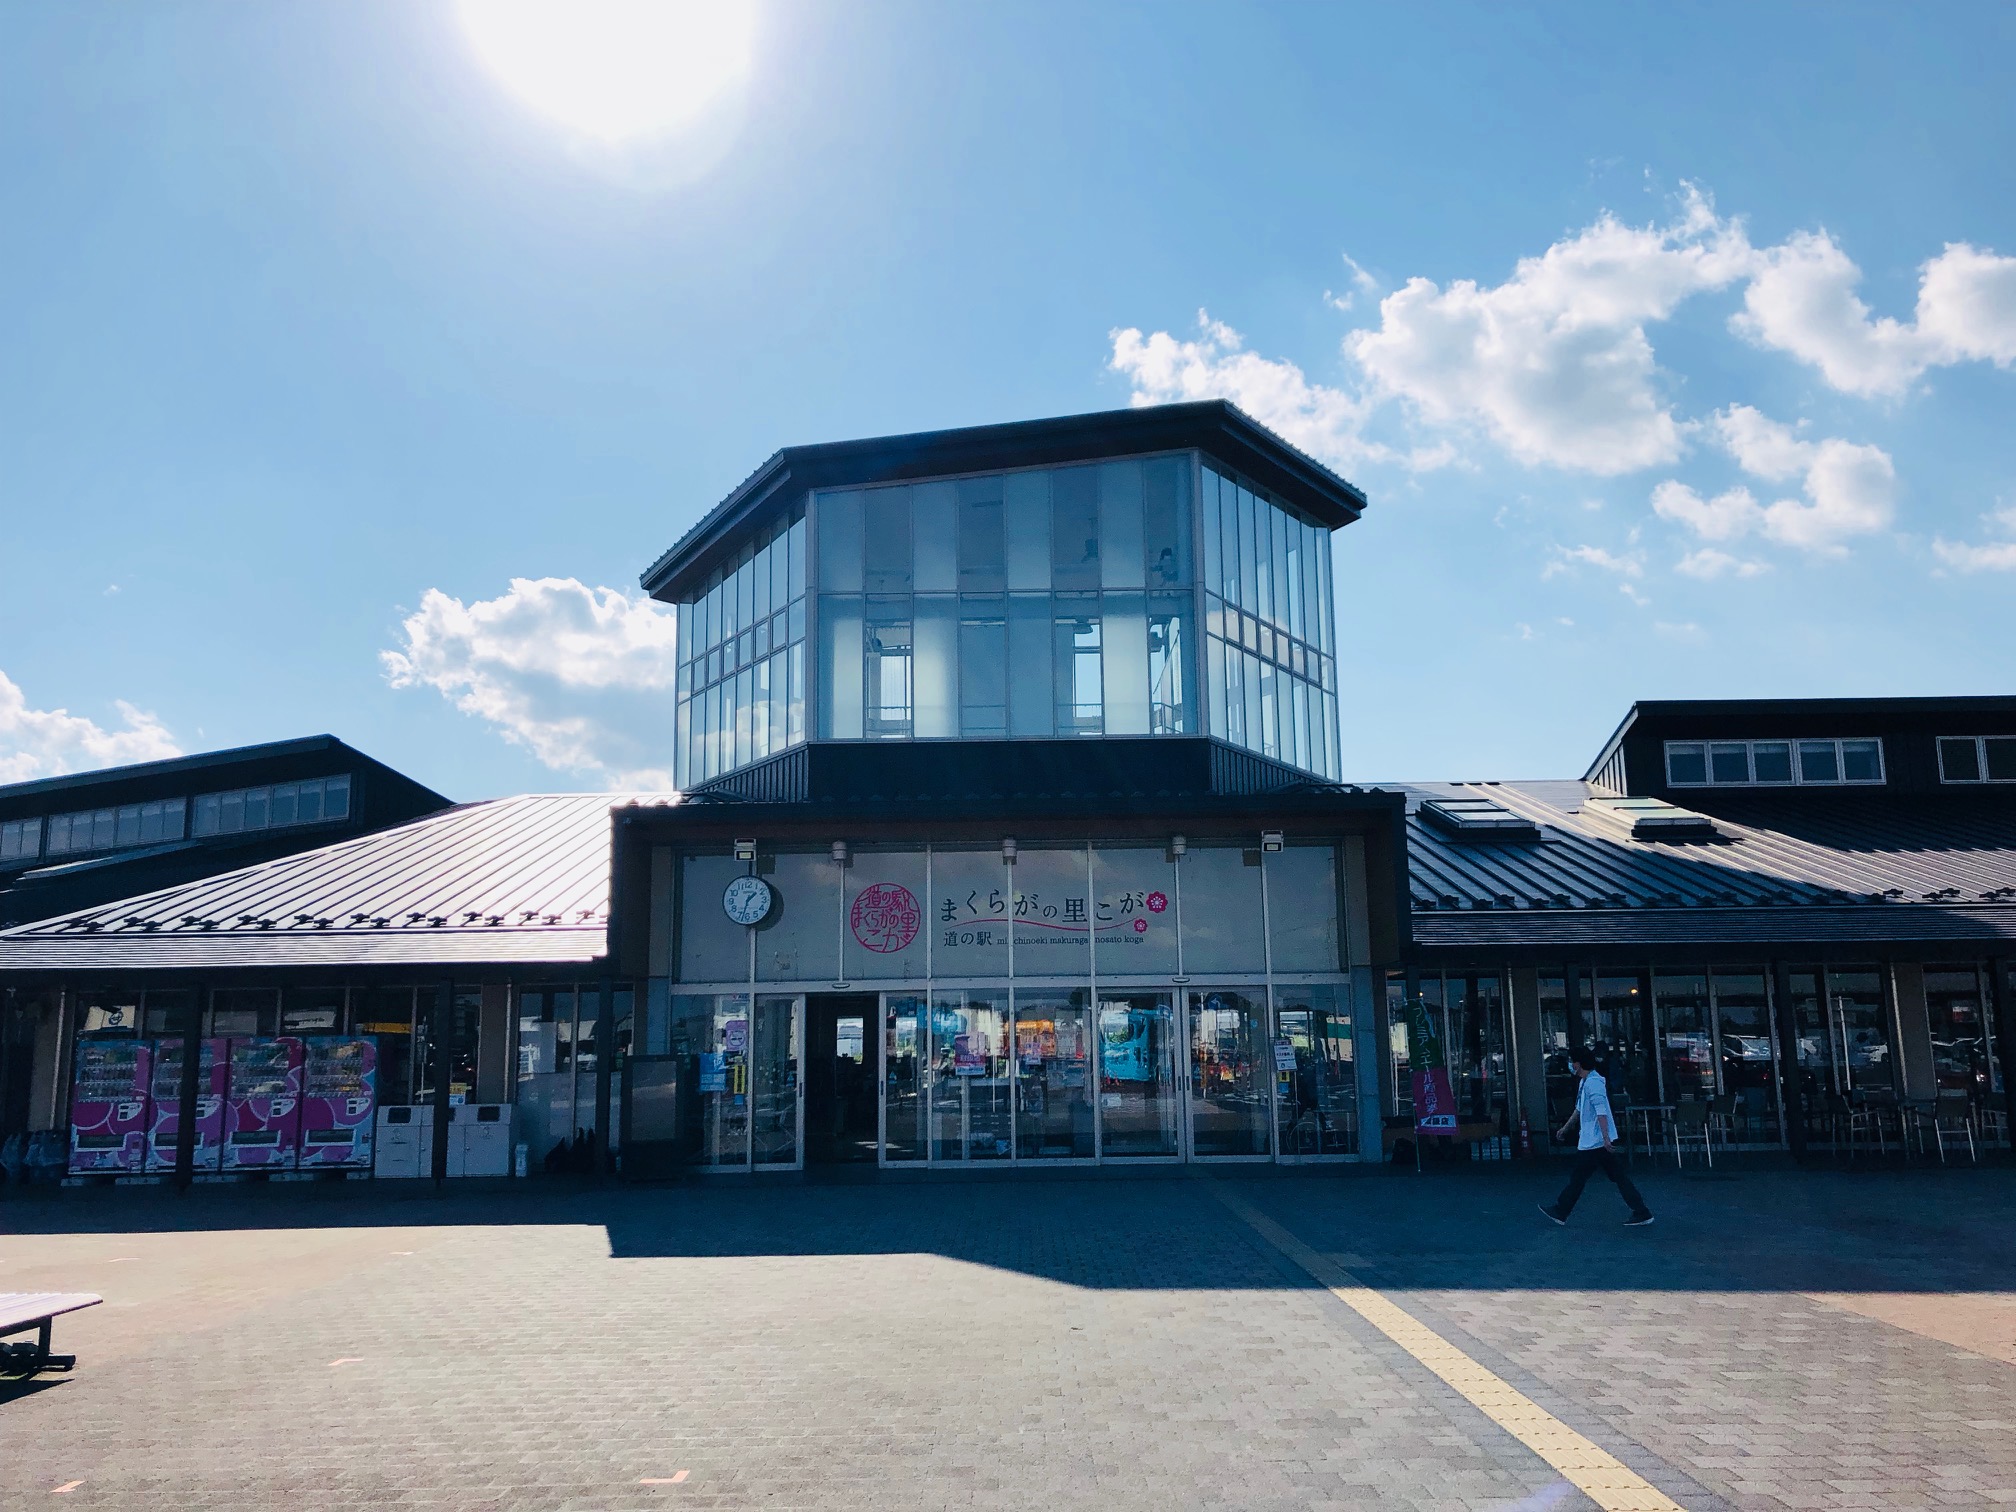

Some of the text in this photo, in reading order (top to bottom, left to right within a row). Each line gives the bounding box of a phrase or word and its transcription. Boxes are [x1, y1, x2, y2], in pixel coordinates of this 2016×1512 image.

[943, 931, 992, 947] 道の駅
[1124, 935, 1144, 945] koga
